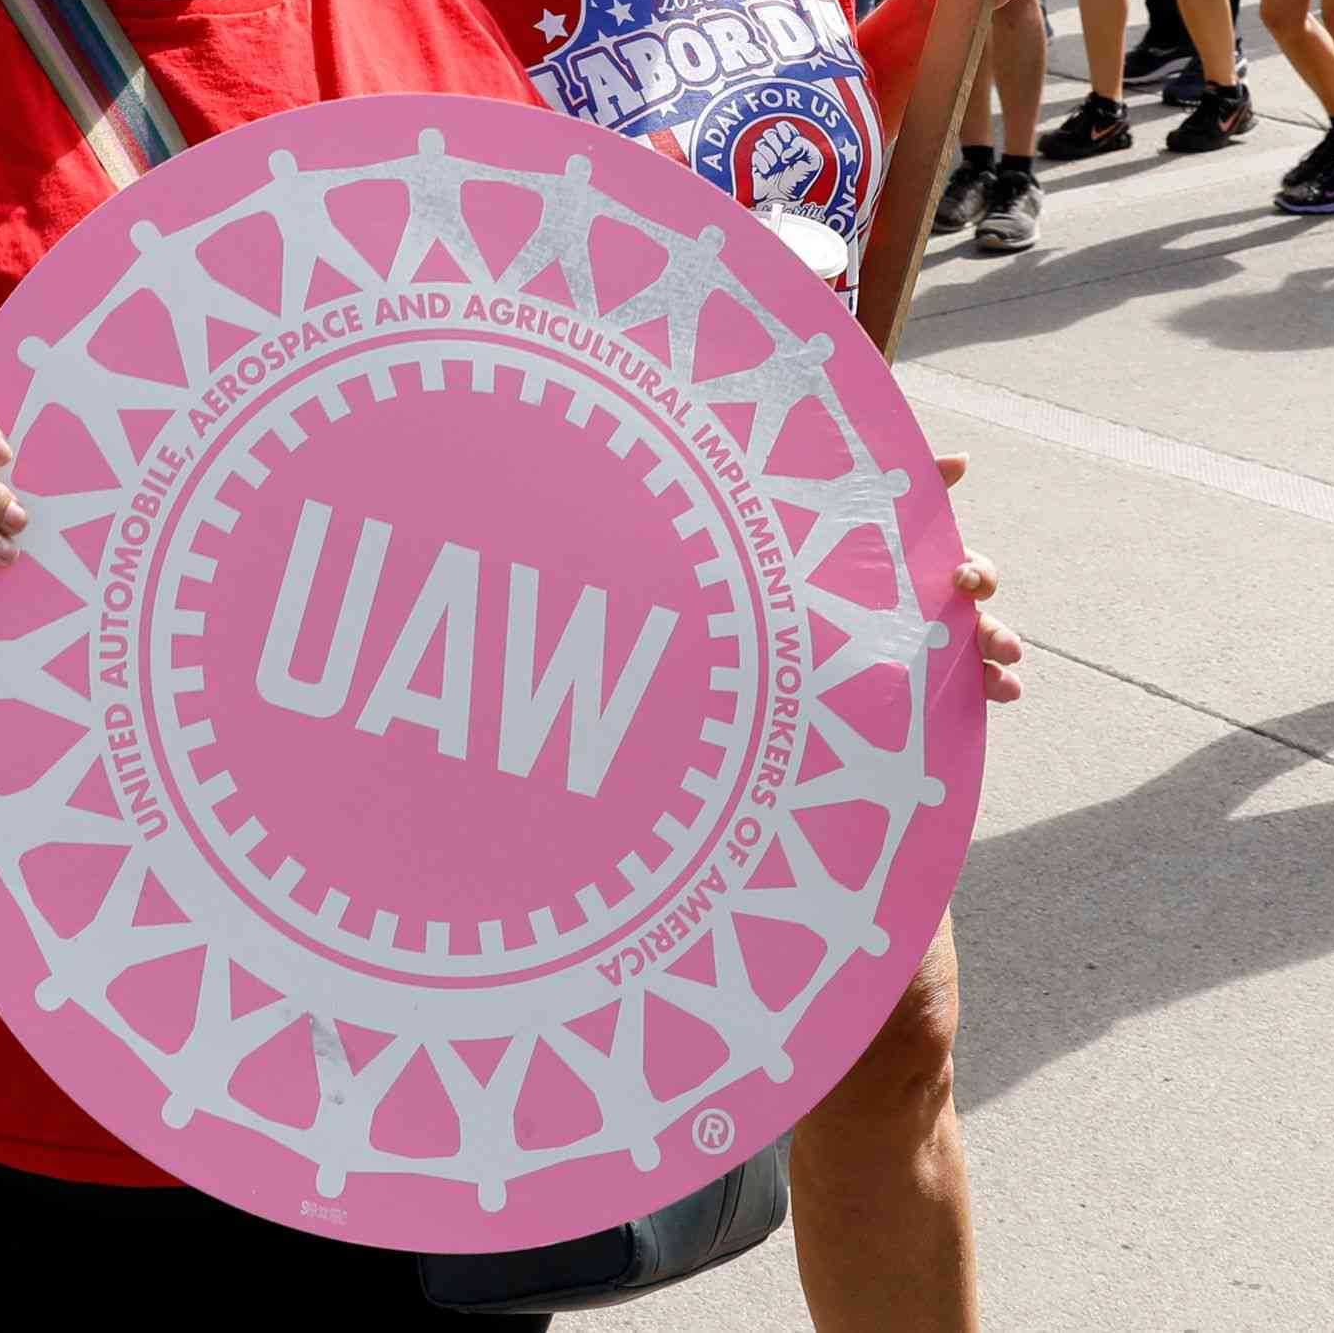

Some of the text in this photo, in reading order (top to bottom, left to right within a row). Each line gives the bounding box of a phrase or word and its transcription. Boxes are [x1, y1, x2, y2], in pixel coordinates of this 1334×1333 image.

[702, 87, 841, 172] A DAY FOR US
[99, 290, 802, 987] UNITED AUTOMOBILE, AEROSPACE AND AGRICULTURAL IMPLEMENT WORKERS OF AMERICA
[255, 497, 682, 800] UAW
